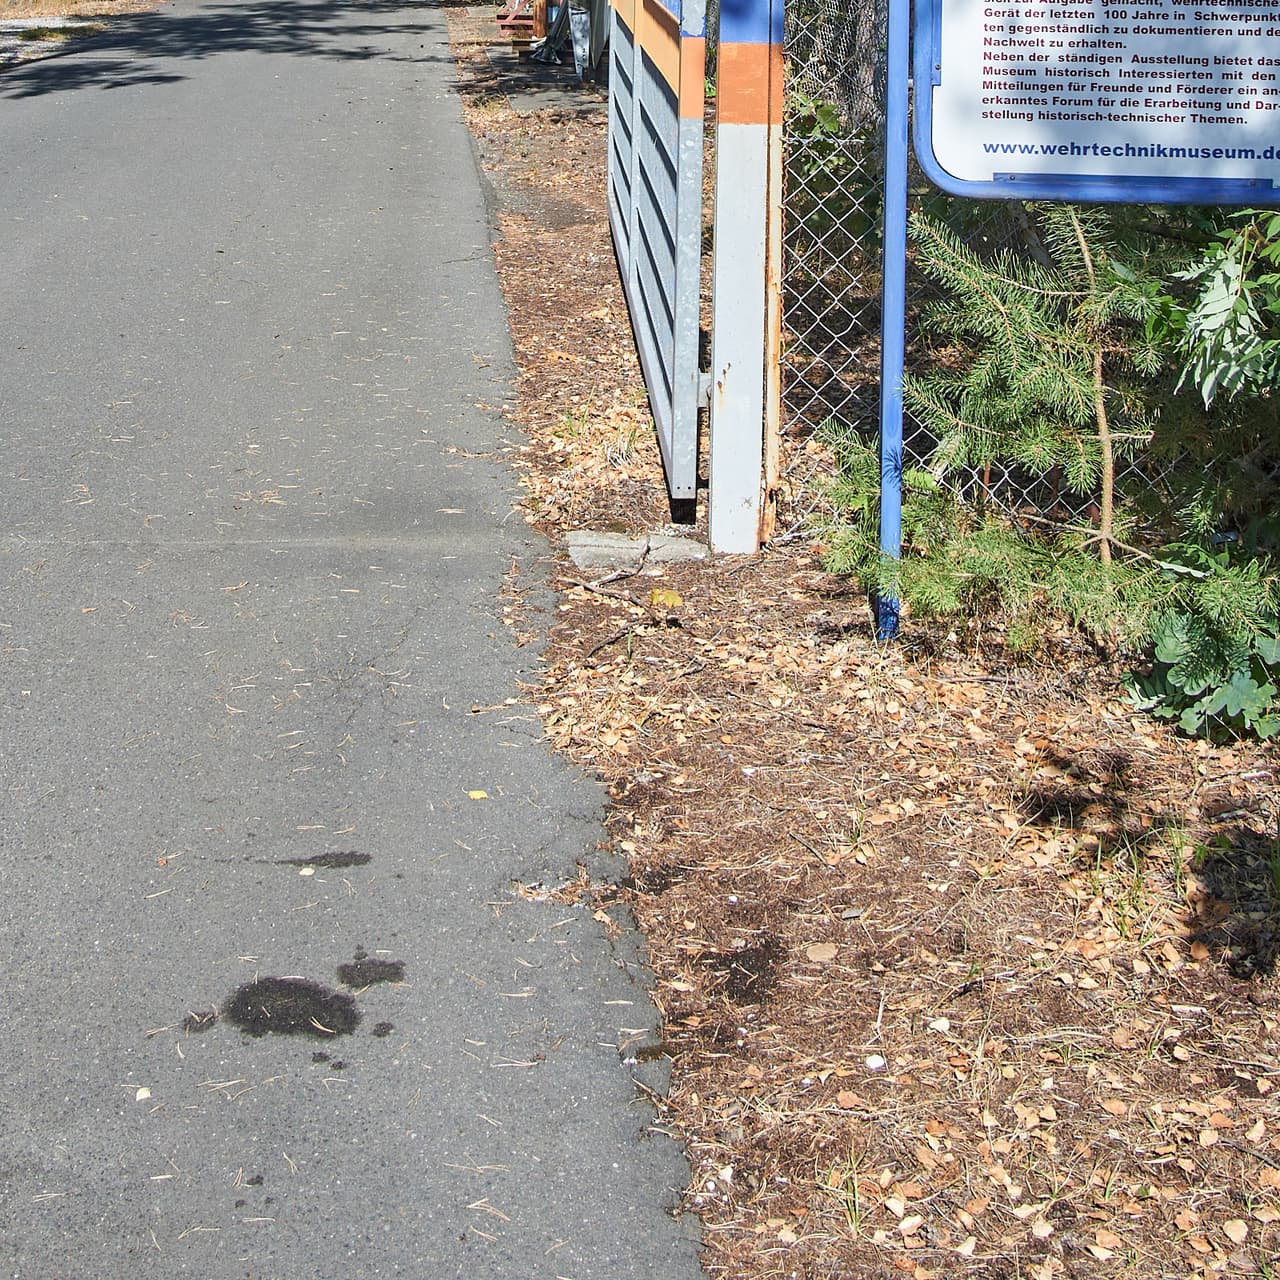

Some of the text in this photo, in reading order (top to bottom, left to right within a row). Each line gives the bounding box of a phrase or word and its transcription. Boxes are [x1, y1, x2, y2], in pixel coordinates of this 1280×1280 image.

[984, 8, 1021, 17] Gerät
[1024, 9, 1047, 17] der
[1050, 9, 1095, 18] letzten
[1103, 9, 1128, 19] 100
[1131, 10, 1170, 20] Jahre
[1173, 11, 1186, 20] in
[984, 23, 1004, 32] ten
[1008, 24, 1110, 34] gegenständlich
[1132, 25, 1233, 35] dokumentieren
[1237, 27, 1262, 36] und
[983, 37, 1045, 47] Nachwelt
[1068, 38, 1127, 48] erhalten.
[983, 51, 1280, 67] Neben der ständigen Ausstellung bietet das
[983, 66, 1276, 80] Museum historisch Interessierten mit den
[982, 80, 1064, 93] Mitteilungen
[1068, 82, 1087, 91] für
[1090, 82, 1144, 92] Freunde
[1148, 84, 1172, 93] und
[1176, 84, 1234, 94] Förderer
[1237, 85, 1258, 95] ein
[982, 95, 1048, 105] erkanntes
[1052, 96, 1093, 106] Forum
[1097, 97, 1116, 106] für
[1120, 97, 1140, 107] die
[1144, 98, 1222, 111] Erarbeitung
[1226, 100, 1250, 109] und
[982, 109, 1248, 124] stellung historisch-technischer Themen.
